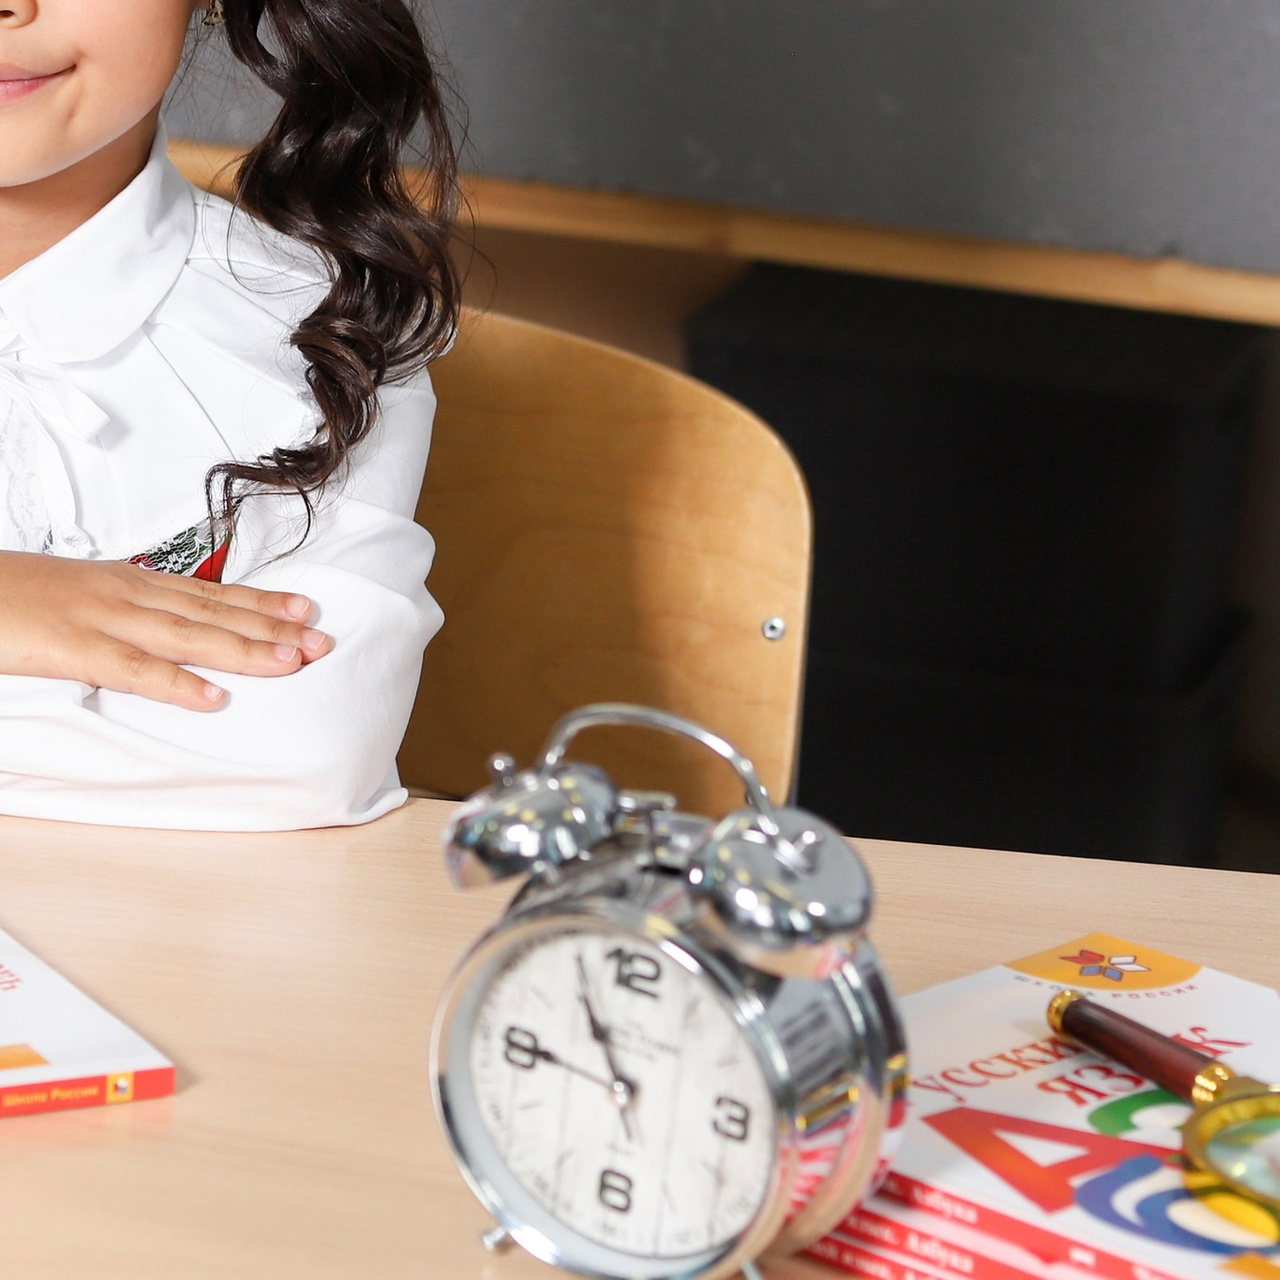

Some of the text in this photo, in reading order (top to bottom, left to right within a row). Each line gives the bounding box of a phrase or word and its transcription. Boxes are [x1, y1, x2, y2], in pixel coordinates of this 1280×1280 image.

[605, 948, 661, 999] 12
[1014, 974, 1096, 998] ШКОА
[505, 1026, 539, 1069] 9
[1037, 1027, 1252, 1107] язк
[713, 1096, 750, 1142] 3
[599, 1168, 633, 1213] 6
